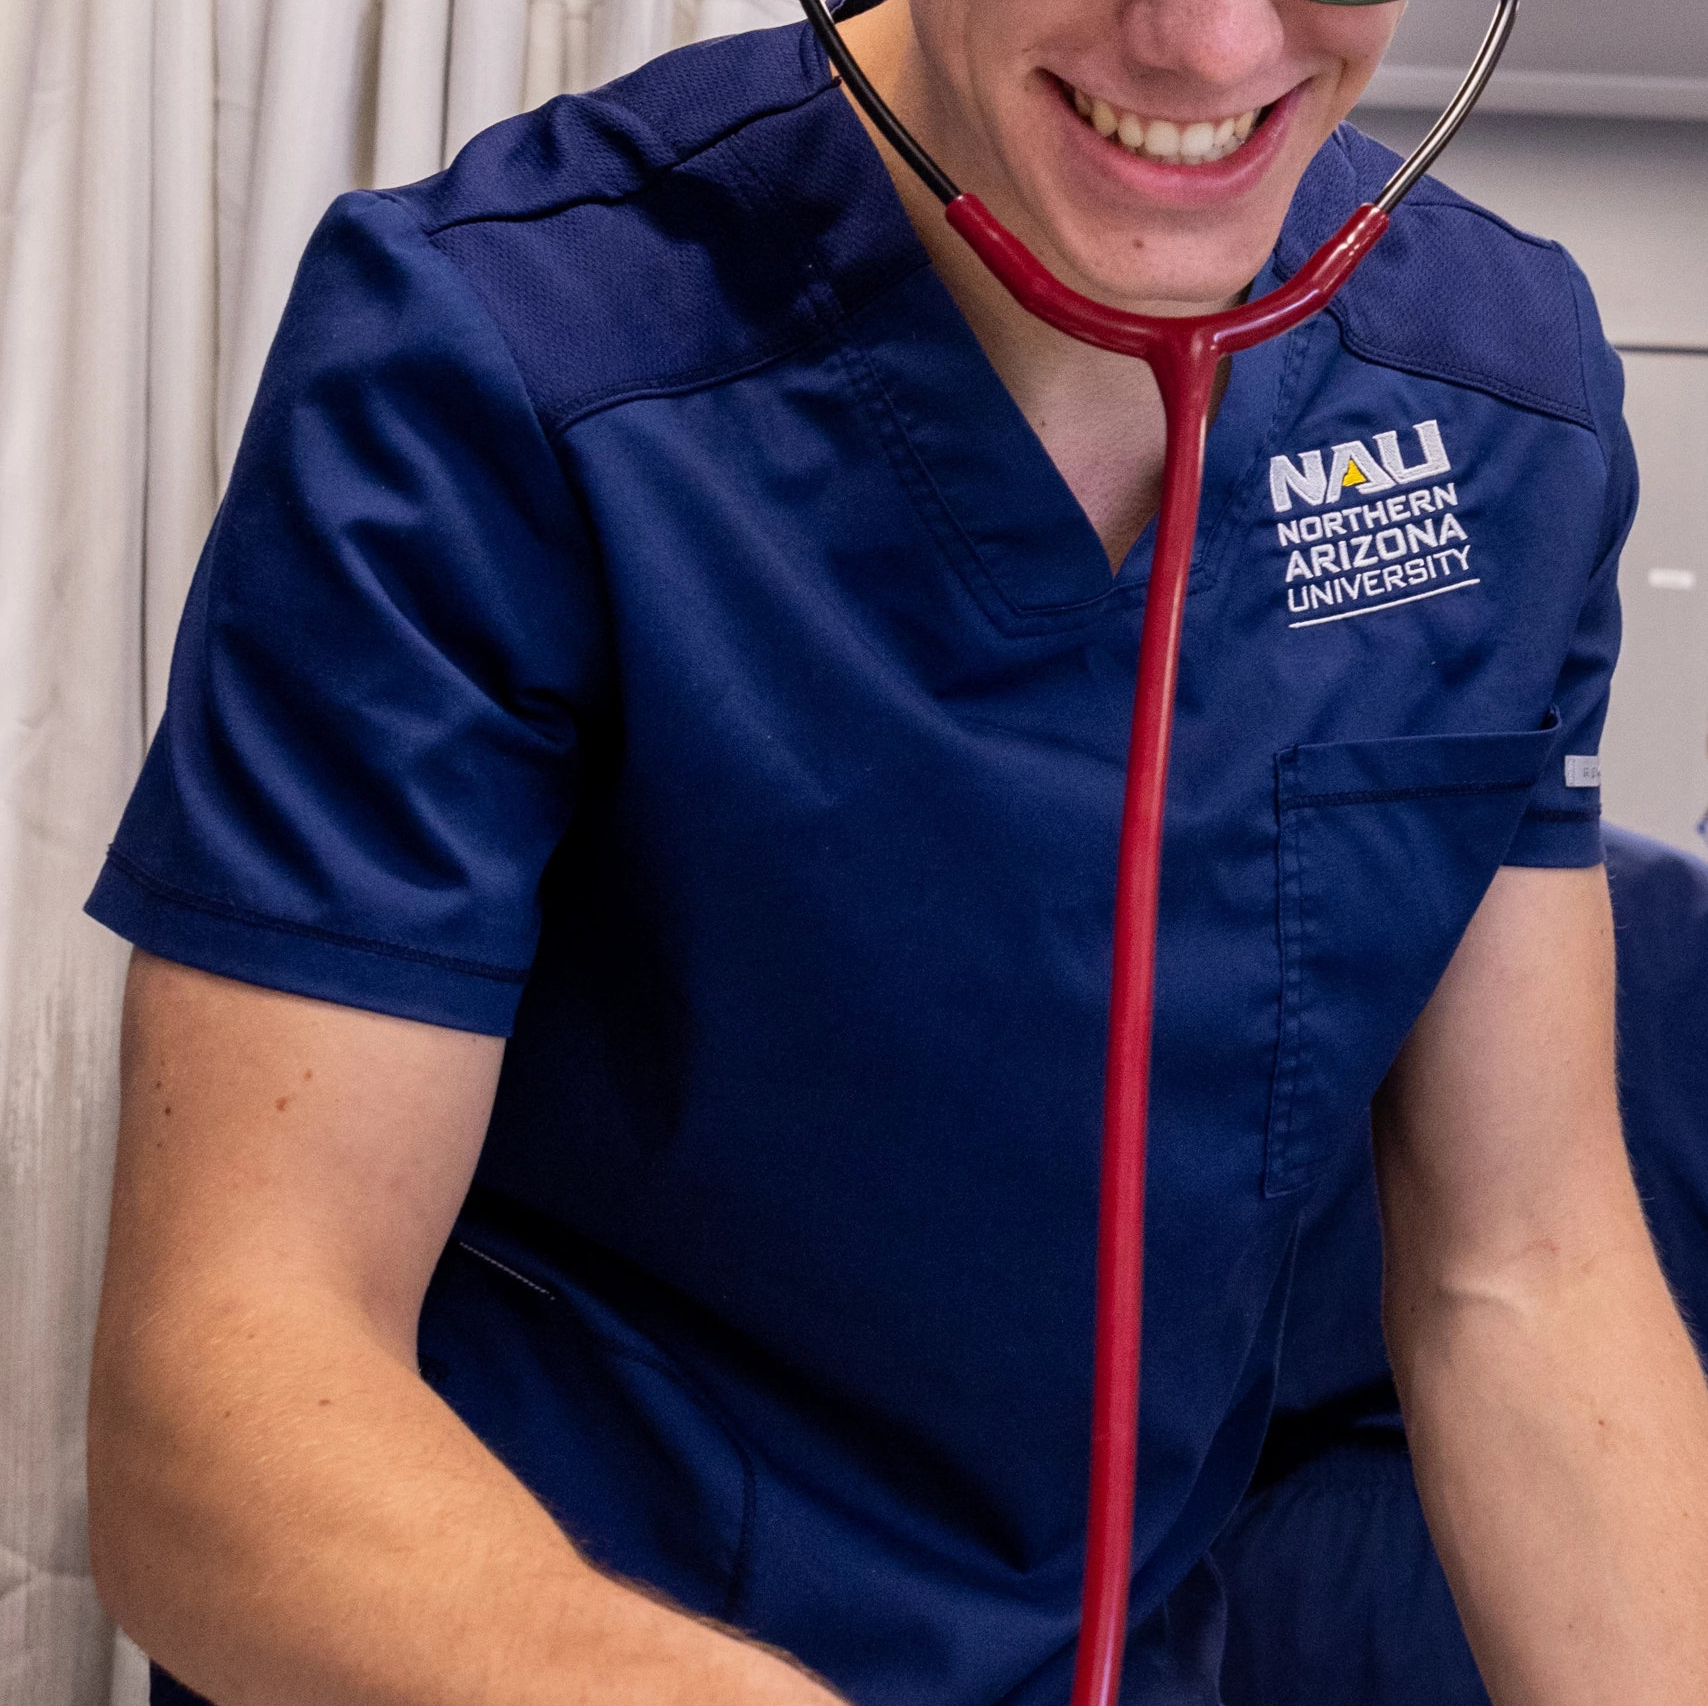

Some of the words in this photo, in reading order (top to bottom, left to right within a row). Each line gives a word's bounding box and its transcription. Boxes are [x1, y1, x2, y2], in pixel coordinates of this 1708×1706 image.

[1270, 419, 1450, 512] NAU
[1277, 482, 1459, 546] NORTHERN
[1285, 513, 1468, 582] ARIZONA
[1287, 545, 1471, 613] UNIVERSITY
